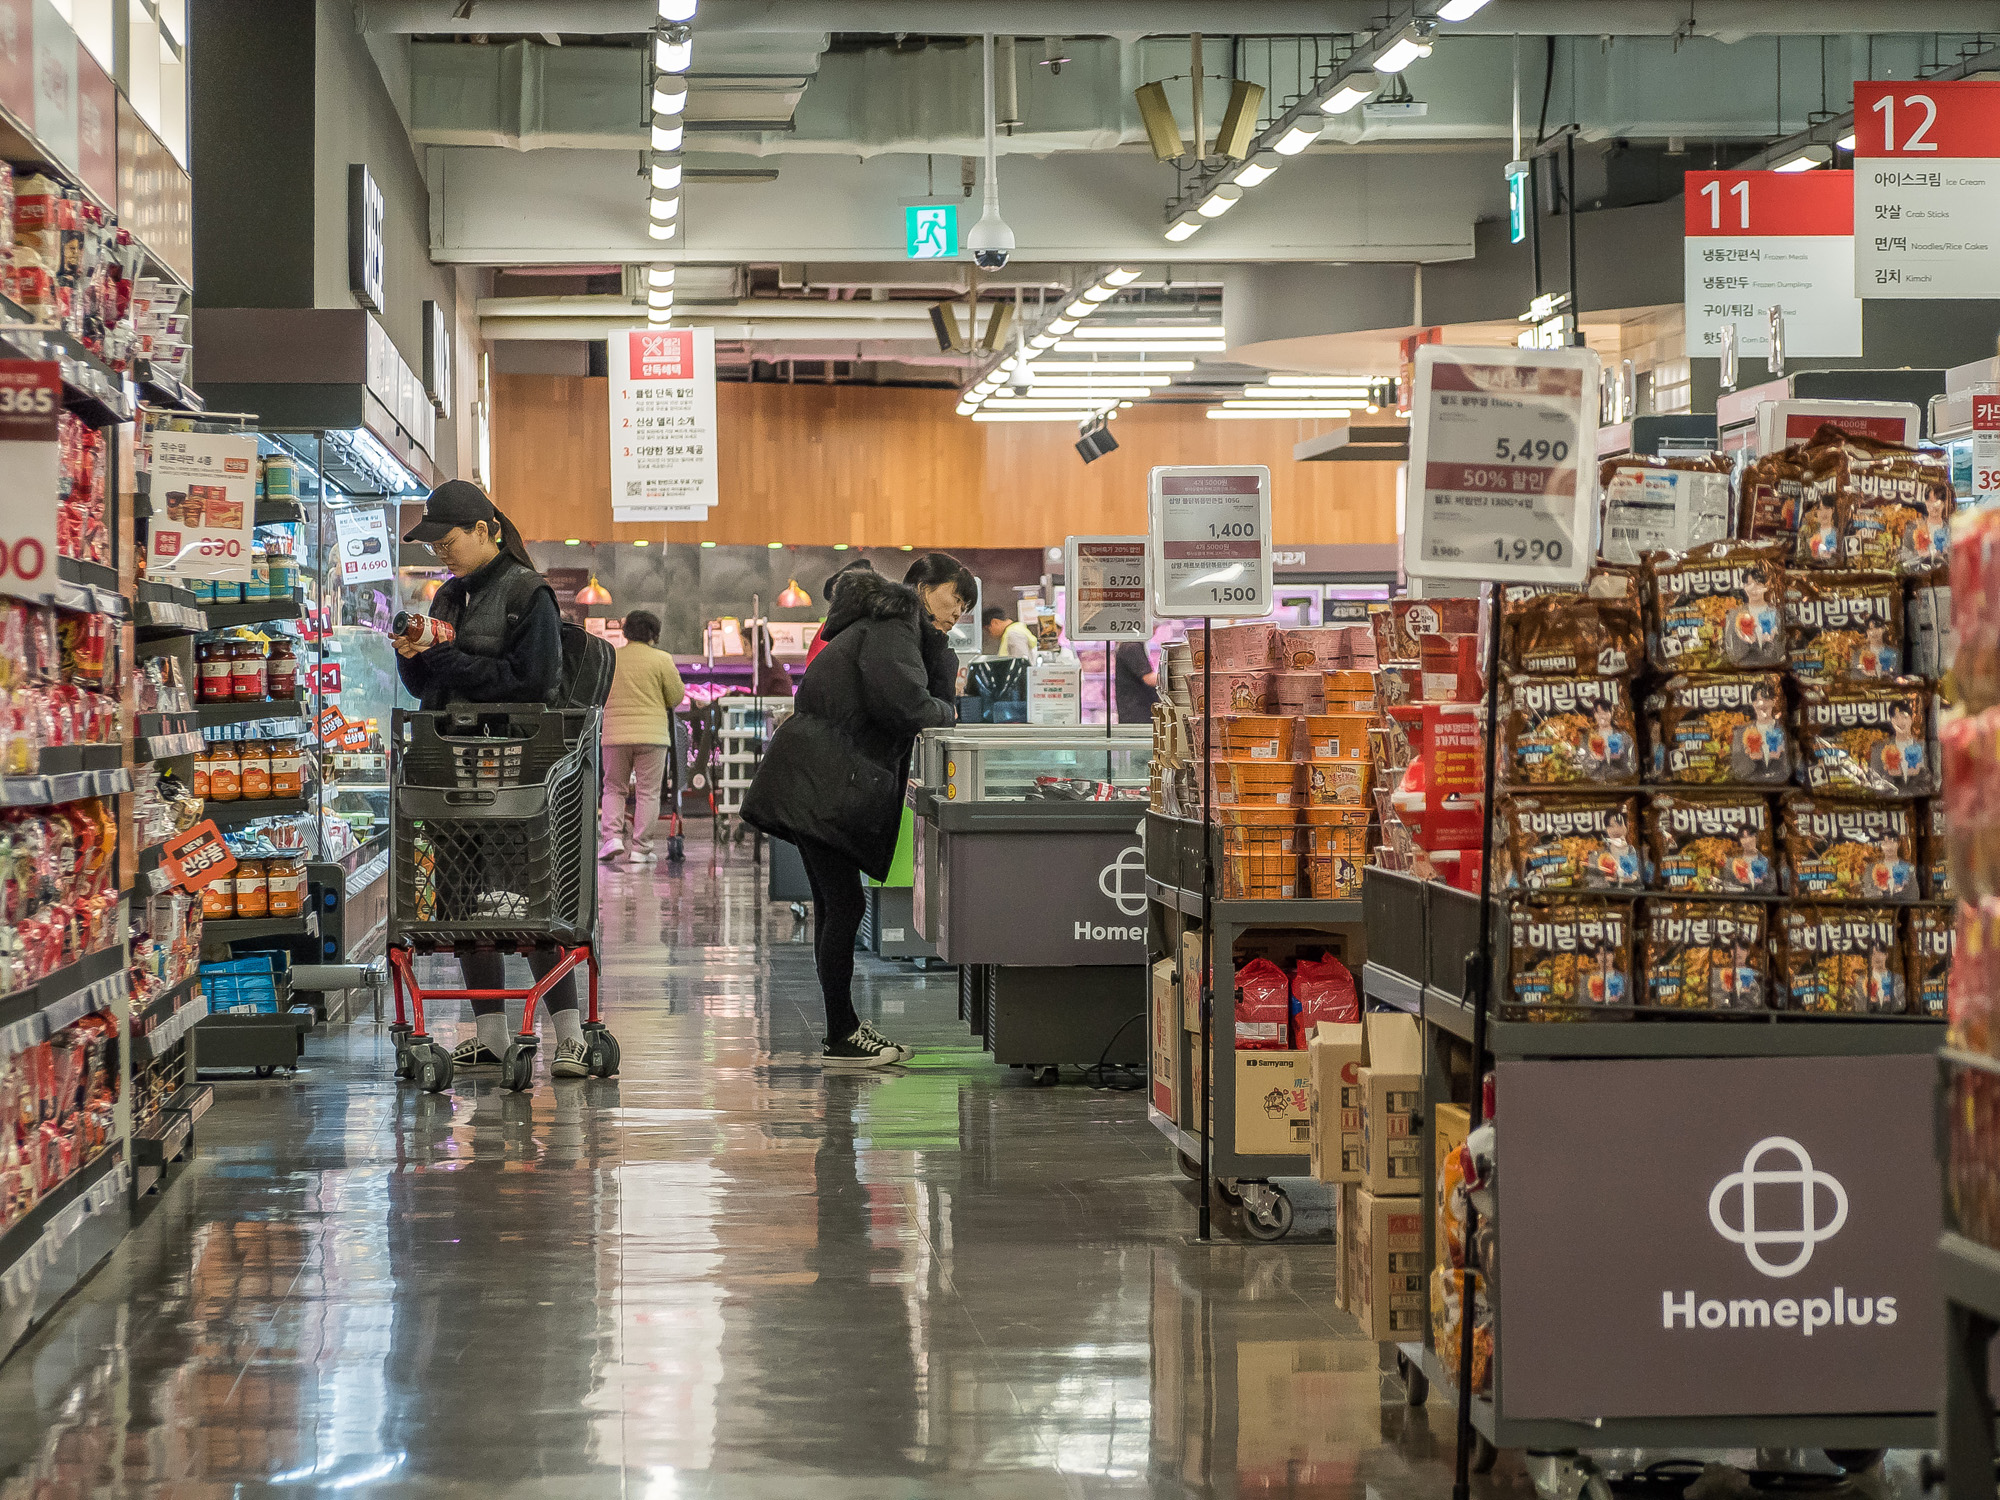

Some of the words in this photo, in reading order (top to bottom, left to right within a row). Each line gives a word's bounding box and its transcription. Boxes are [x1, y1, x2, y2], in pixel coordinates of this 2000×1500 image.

[1872, 94, 1938, 151] 12
[1875, 173, 1941, 187] 아이스크림
[1701, 181, 1750, 229] 11
[1875, 205, 1901, 219] 맛살
[1875, 237, 1907, 251] 면/떡
[1911, 243, 1962, 251] Noodles/Rice
[1703, 249, 1760, 261] 냉동간편식
[1704, 276, 1749, 289] 냉동만두
[1875, 269, 1901, 283] 김치
[1704, 304, 1753, 317] 구이/튀김
[642, 364, 681, 376] 단독혜택
[622, 390, 630, 399] 1.
[656, 388, 673, 398] 단독
[677, 388, 693, 398] 할인
[623, 419, 632, 427] 2.
[637, 417, 653, 426] 신상
[657, 417, 674, 426] 델리
[678, 416, 695, 426] 소개
[624, 447, 633, 456] 3.
[637, 446, 662, 456] 다양한
[666, 446, 683, 455] 정보
[687, 445, 703, 454] 제공
[1496, 438, 1568, 462] 5,490
[1464, 470, 1507, 488] 50%
[1513, 471, 1544, 489] 할인
[1209, 523, 1254, 539] 1,400
[1494, 538, 1563, 562] 1,990
[361, 560, 387, 571] 4,690
[1110, 576, 1140, 586] 8,720
[1211, 588, 1256, 603] 1,500
[306, 614, 328, 632] 1+1
[1110, 621, 1140, 631] 8,720
[312, 669, 337, 686] 1+1
[322, 717, 344, 735] 신상품
[344, 732, 365, 744] 신상품
[1685, 740, 1702, 750] OK!
[182, 836, 204, 854] NEW
[181, 842, 225, 877] 신상품
[1542, 864, 1559, 874] OK!
[1670, 875, 1688, 886] OK!
[1809, 880, 1826, 890] OK!
[1258, 1060, 1293, 1068] Samyang
[1662, 1287, 1898, 1336] Homeplus
